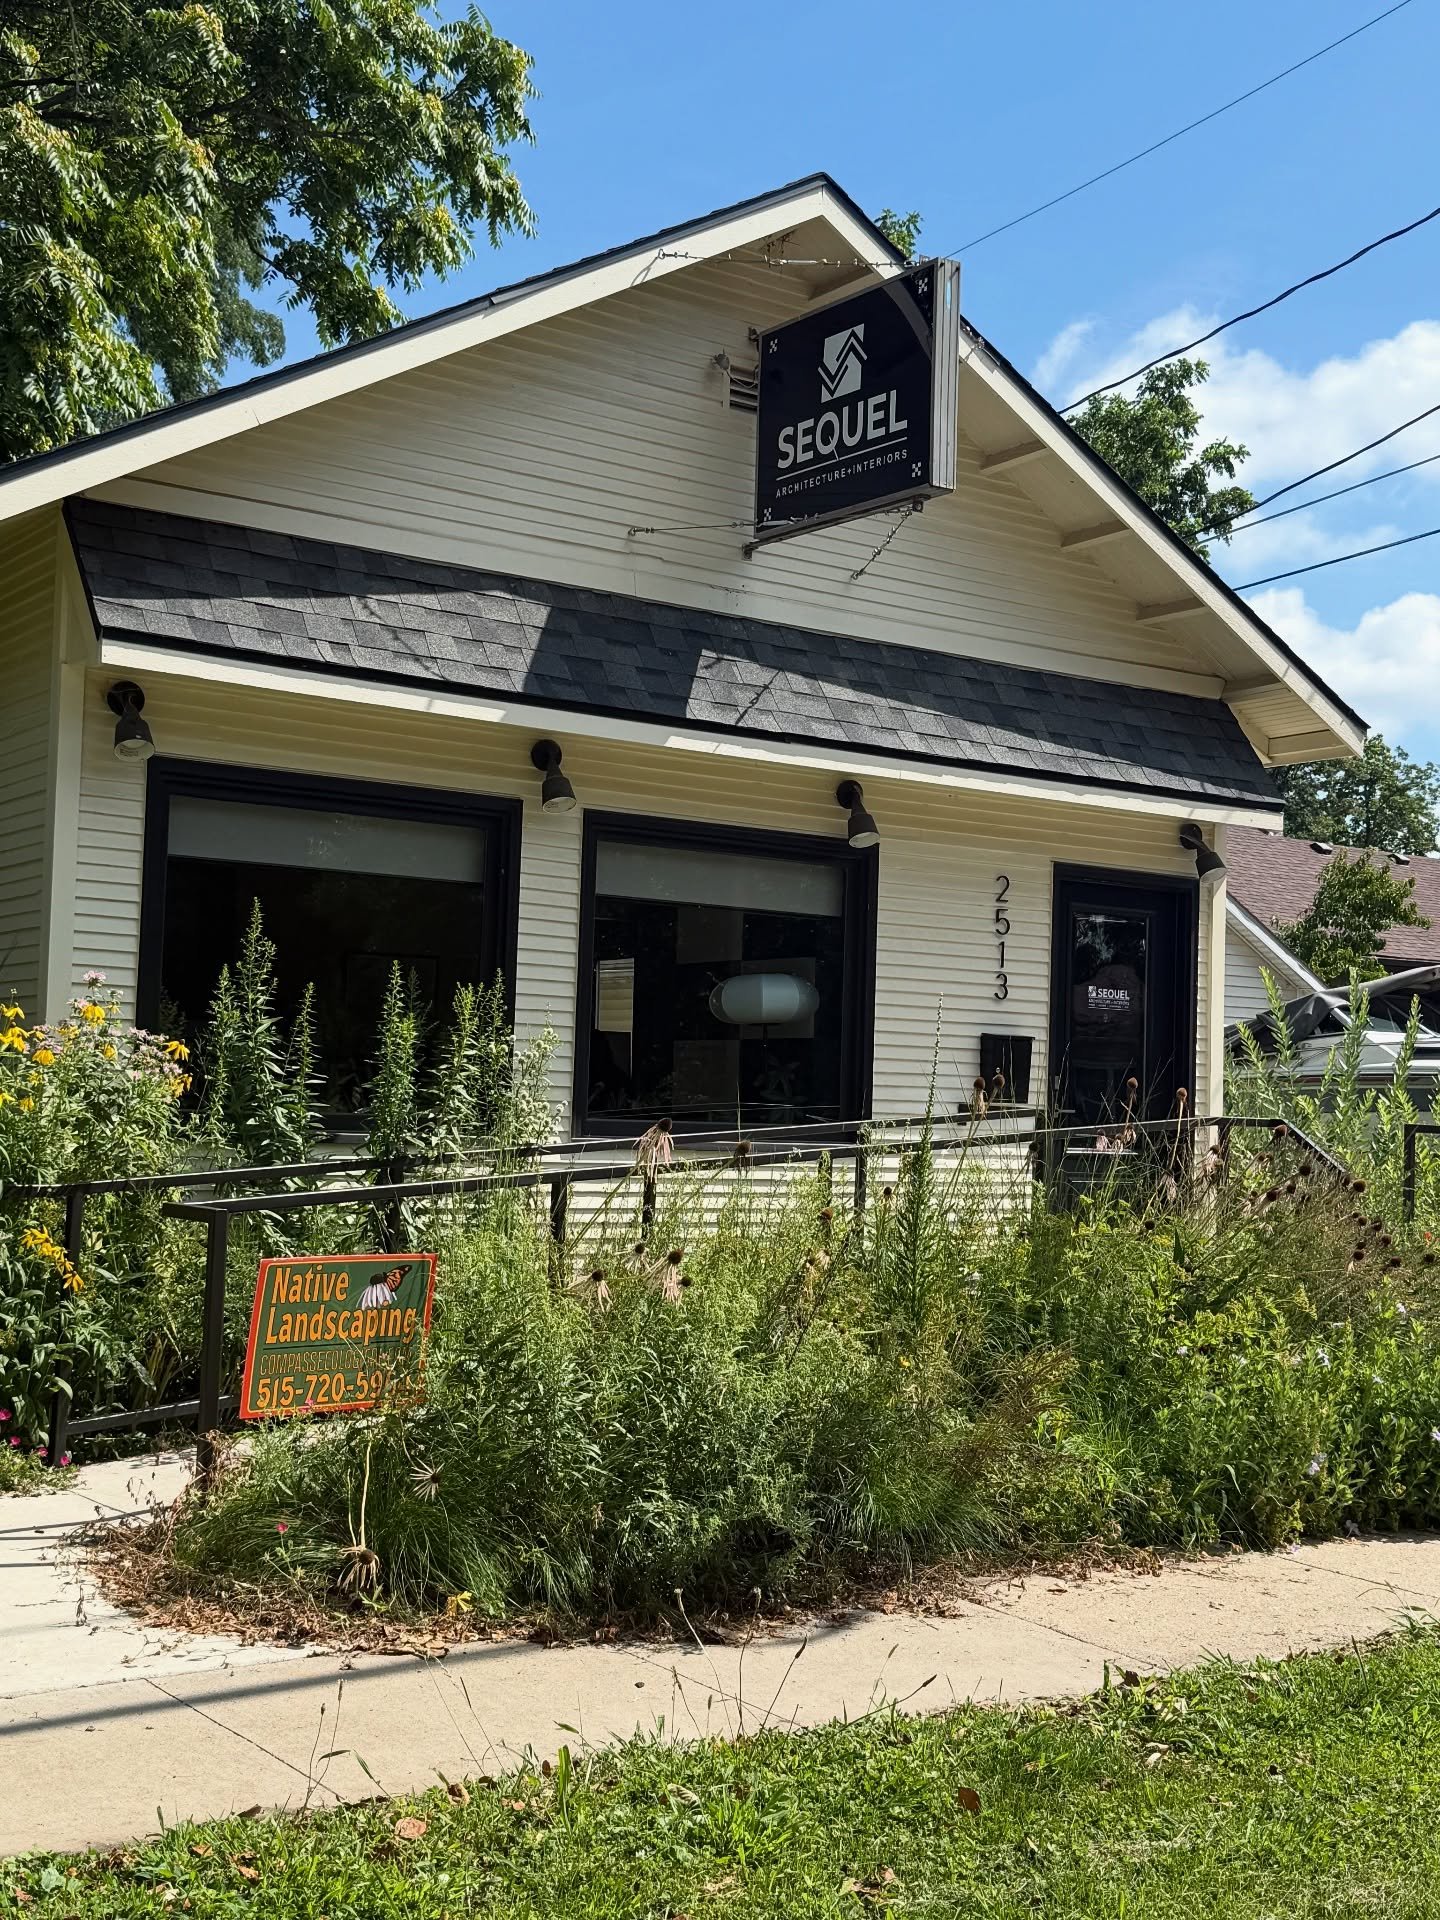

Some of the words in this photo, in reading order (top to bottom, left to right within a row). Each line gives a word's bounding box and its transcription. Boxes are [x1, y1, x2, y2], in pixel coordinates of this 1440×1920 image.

[777, 389, 908, 469] SEQUEL
[993, 875, 1011, 1001] 2513
[1097, 988, 1130, 1000] SEQUEL
[271, 1264, 350, 1305] Native
[265, 1300, 417, 1346] Landscaping
[256, 1369, 414, 1408] 515-720-59
